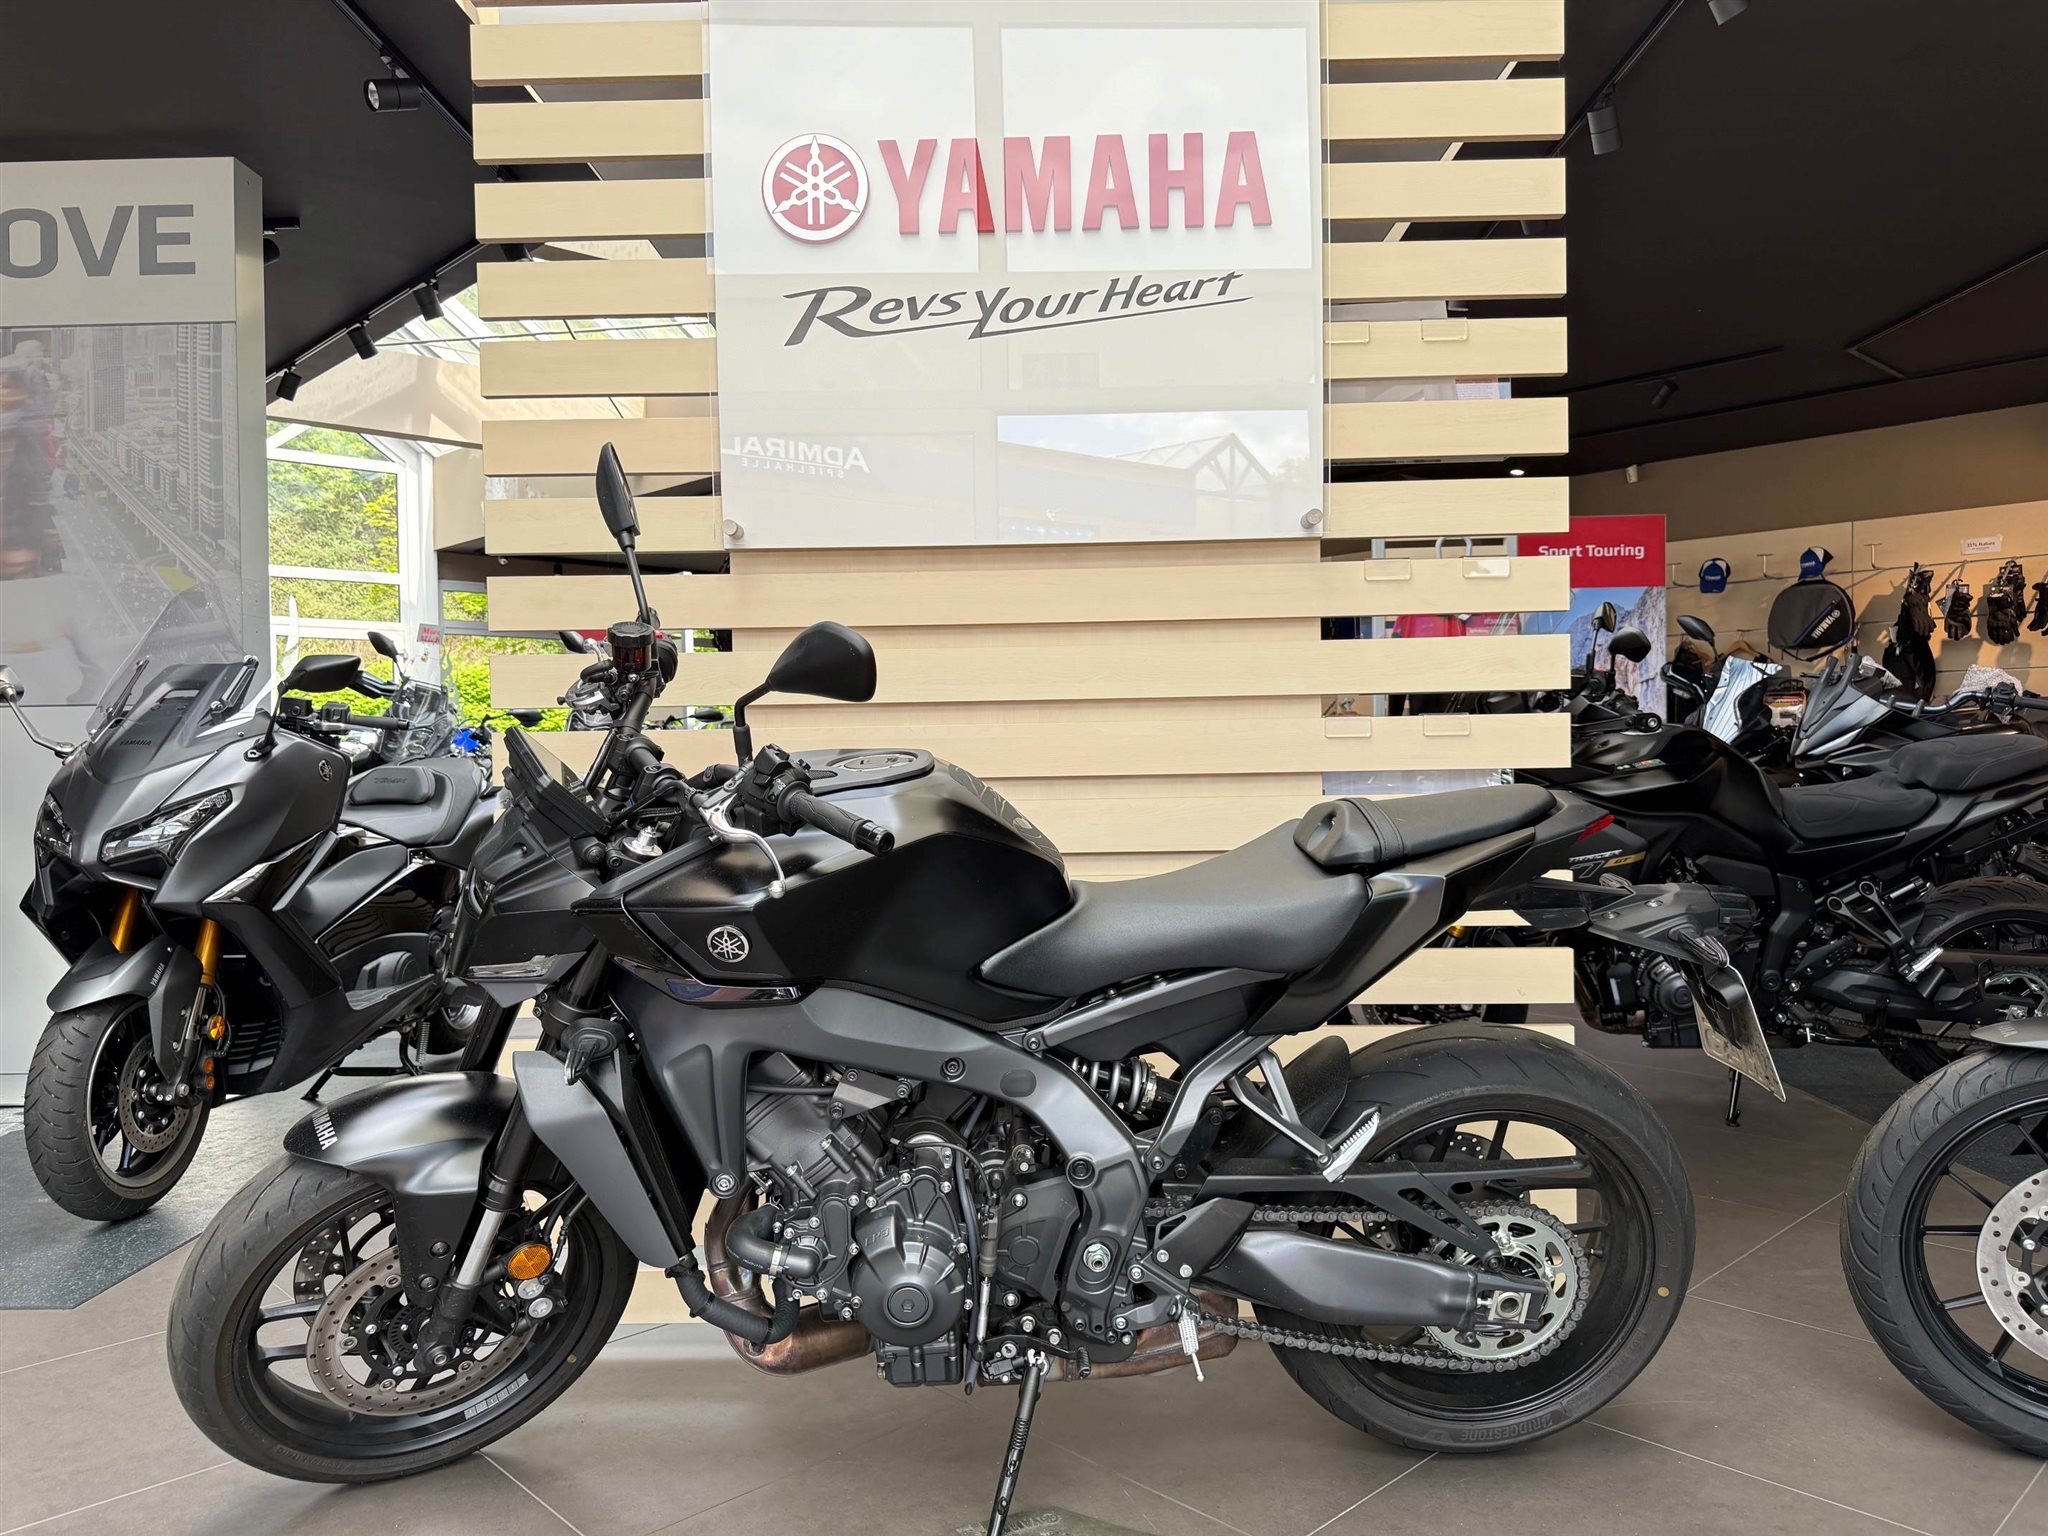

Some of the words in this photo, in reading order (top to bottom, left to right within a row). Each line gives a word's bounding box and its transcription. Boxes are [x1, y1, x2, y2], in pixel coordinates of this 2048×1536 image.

[877, 130, 1273, 236] YAMAHA
[783, 285, 968, 348] Revs
[967, 286, 1099, 340] Your
[1097, 270, 1245, 314] Heart
[1585, 544, 1645, 559] Touring
[1810, 615, 1836, 640] YAMAHA
[150, 962, 165, 987] YAMAHA
